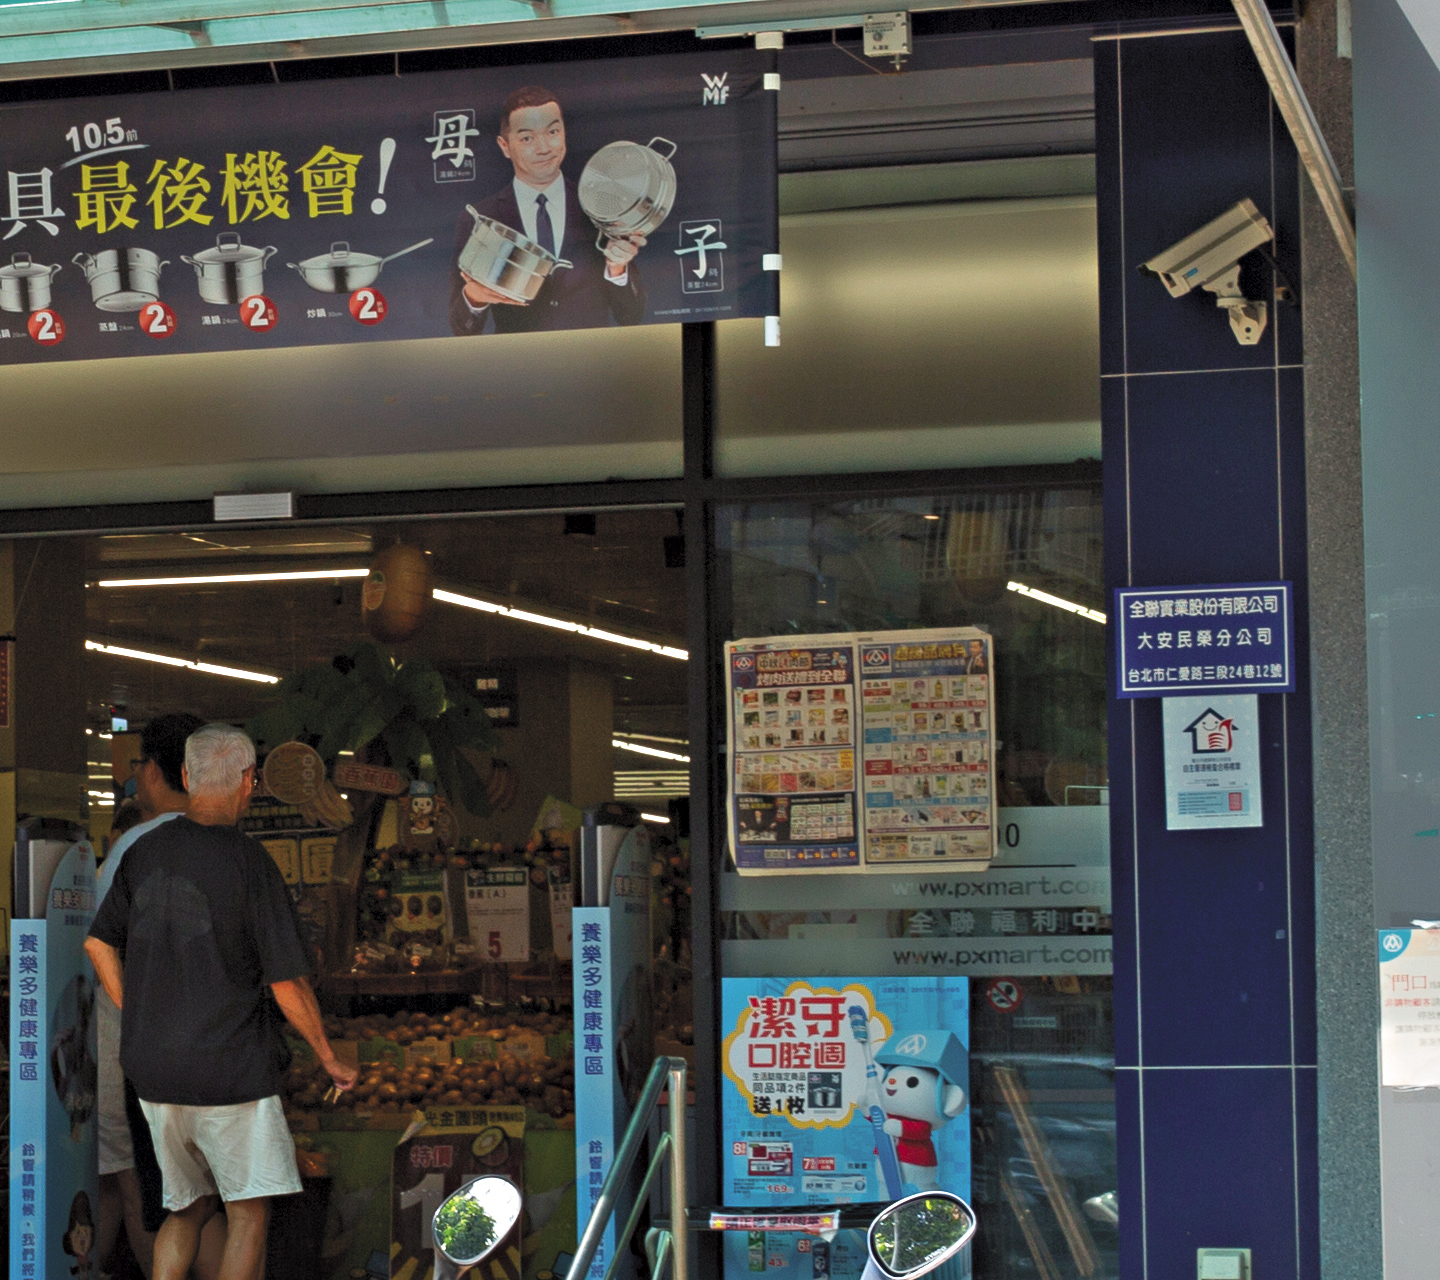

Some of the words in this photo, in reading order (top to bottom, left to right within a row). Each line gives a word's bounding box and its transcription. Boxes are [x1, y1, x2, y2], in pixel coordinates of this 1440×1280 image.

[1129, 595, 1278, 619] 全聯實業股份有限公司
[1137, 627, 1272, 650] 大安民榮分公司
[487, 930, 502, 959] 5
[18, 933, 39, 1081] 養樂多健康專區
[581, 922, 604, 1076] 養樂多健康專區
[747, 995, 847, 1039] 潔牙
[747, 1041, 846, 1070] 口腔週
